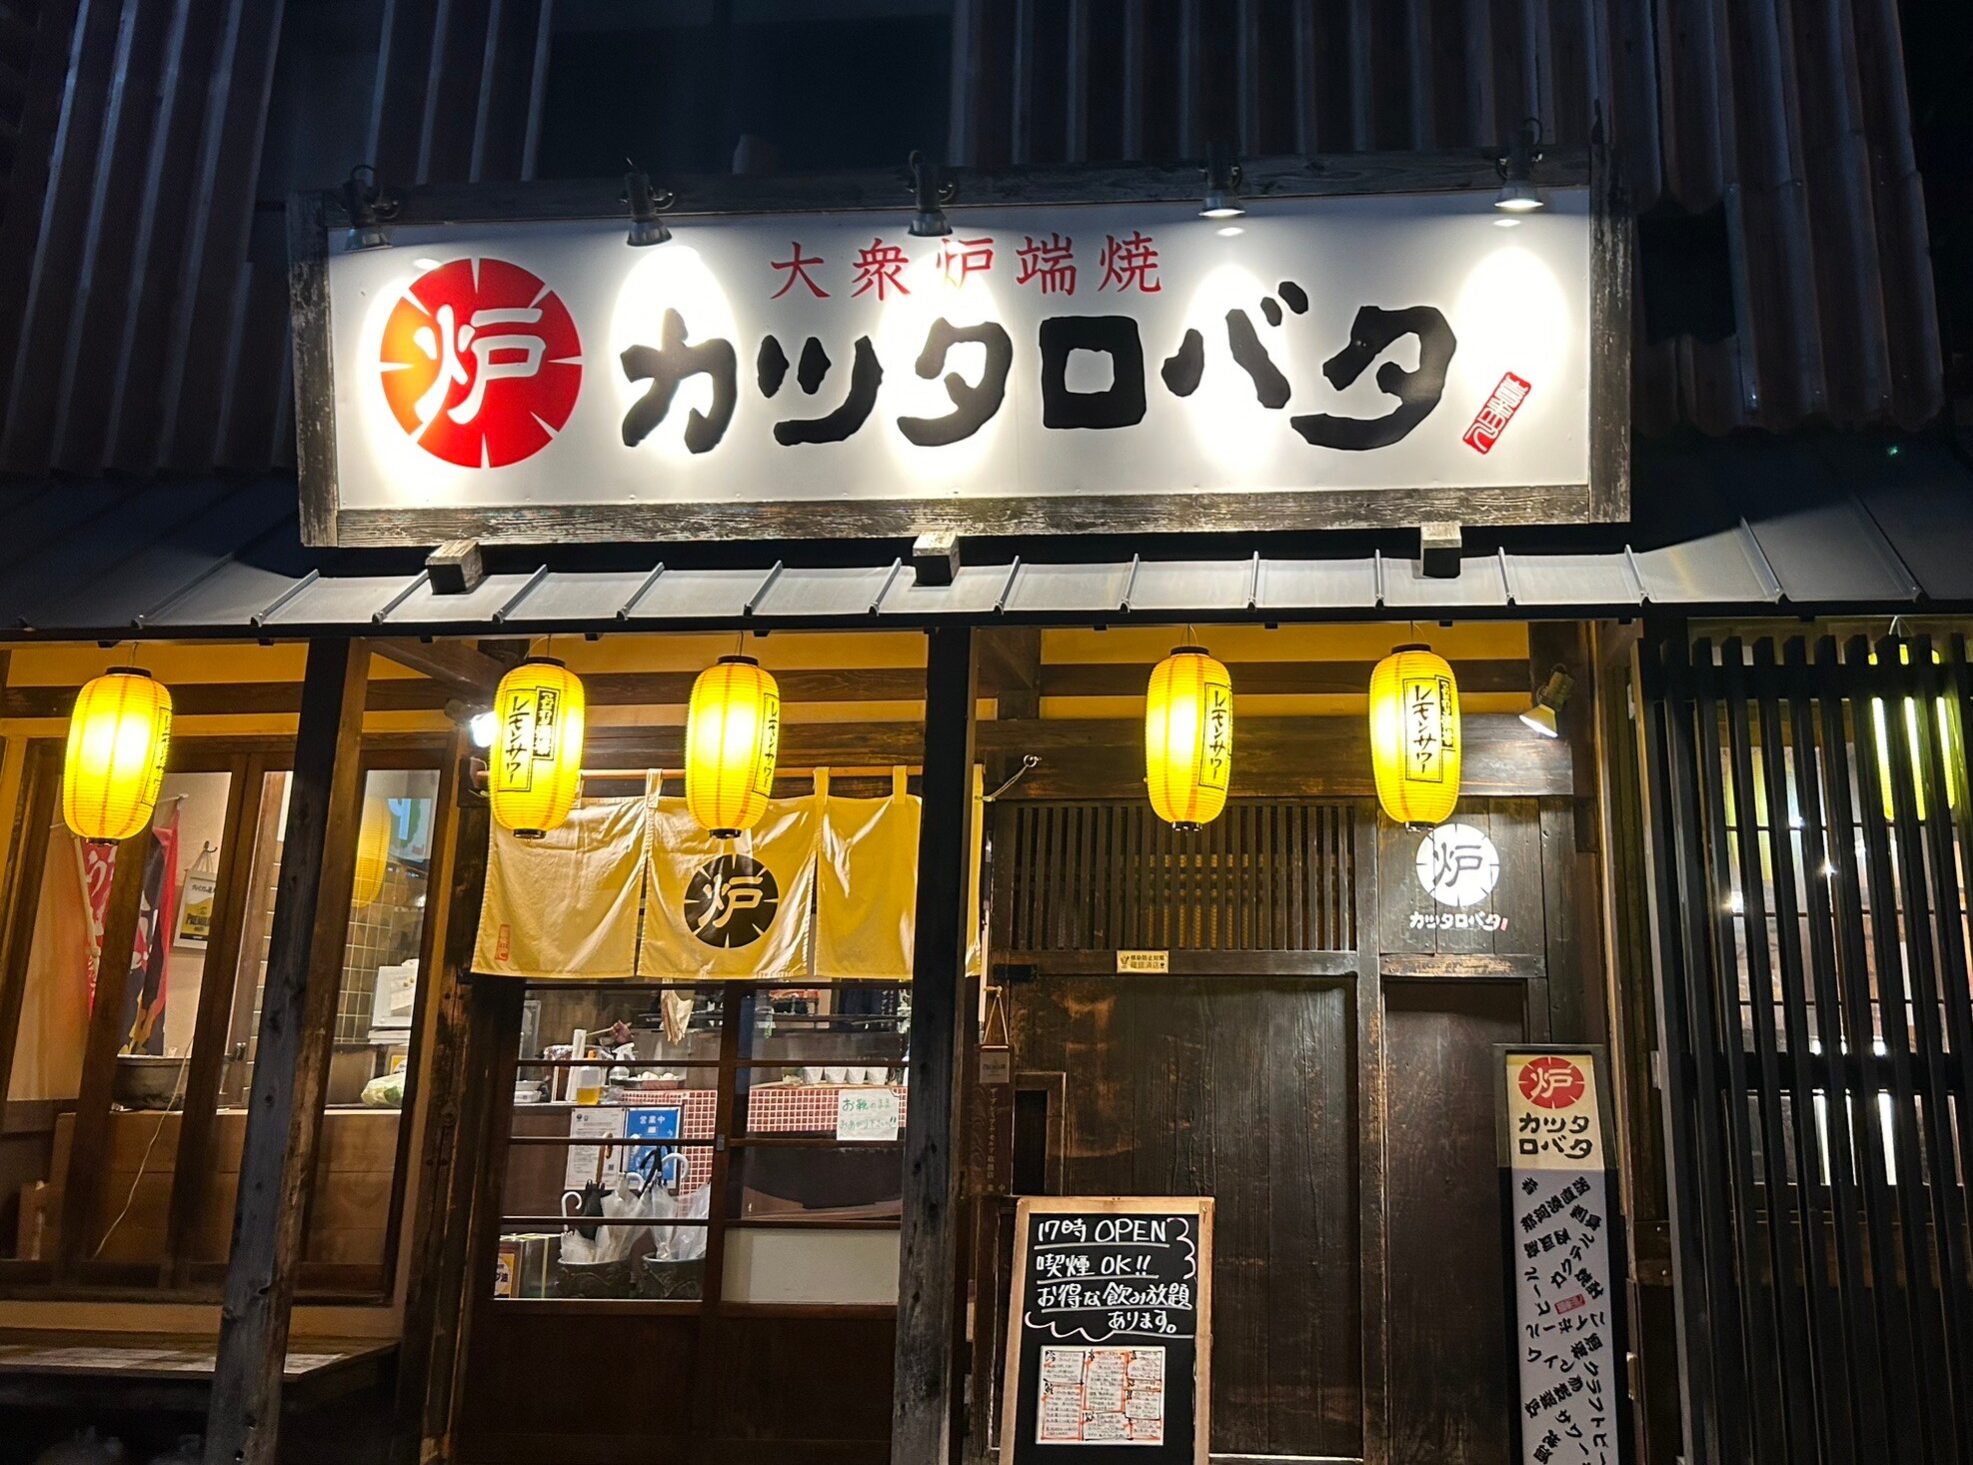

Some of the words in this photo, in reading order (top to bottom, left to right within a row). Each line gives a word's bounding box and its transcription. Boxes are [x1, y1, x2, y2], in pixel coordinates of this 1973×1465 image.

[770, 230, 1163, 300] 大衆炉端焼
[413, 304, 547, 424] 炉
[506, 696, 530, 784] レモンサワー
[1209, 691, 1227, 780] レモンサワー
[1412, 685, 1437, 773] レモンサワー
[1433, 842, 1483, 887] 炉
[697, 875, 765, 928] 炉
[1530, 1067, 1573, 1098] 炉
[1518, 1135, 1593, 1159] ロバタ
[1038, 1218, 1087, 1243] 17時
[1094, 1218, 1167, 1243] OPEN
[1036, 1253, 1095, 1278] 喫煙
[1551, 1233, 1595, 1289] カクテル
[1037, 1281, 1192, 1309] お得な飲み放題
[1574, 1267, 1604, 1299] 焼酎
[1108, 1309, 1178, 1333] あります。
[1527, 1347, 1576, 1373] ワイン
[1533, 1430, 1561, 1464] 地酒
[1555, 1409, 1589, 1455] サワー
